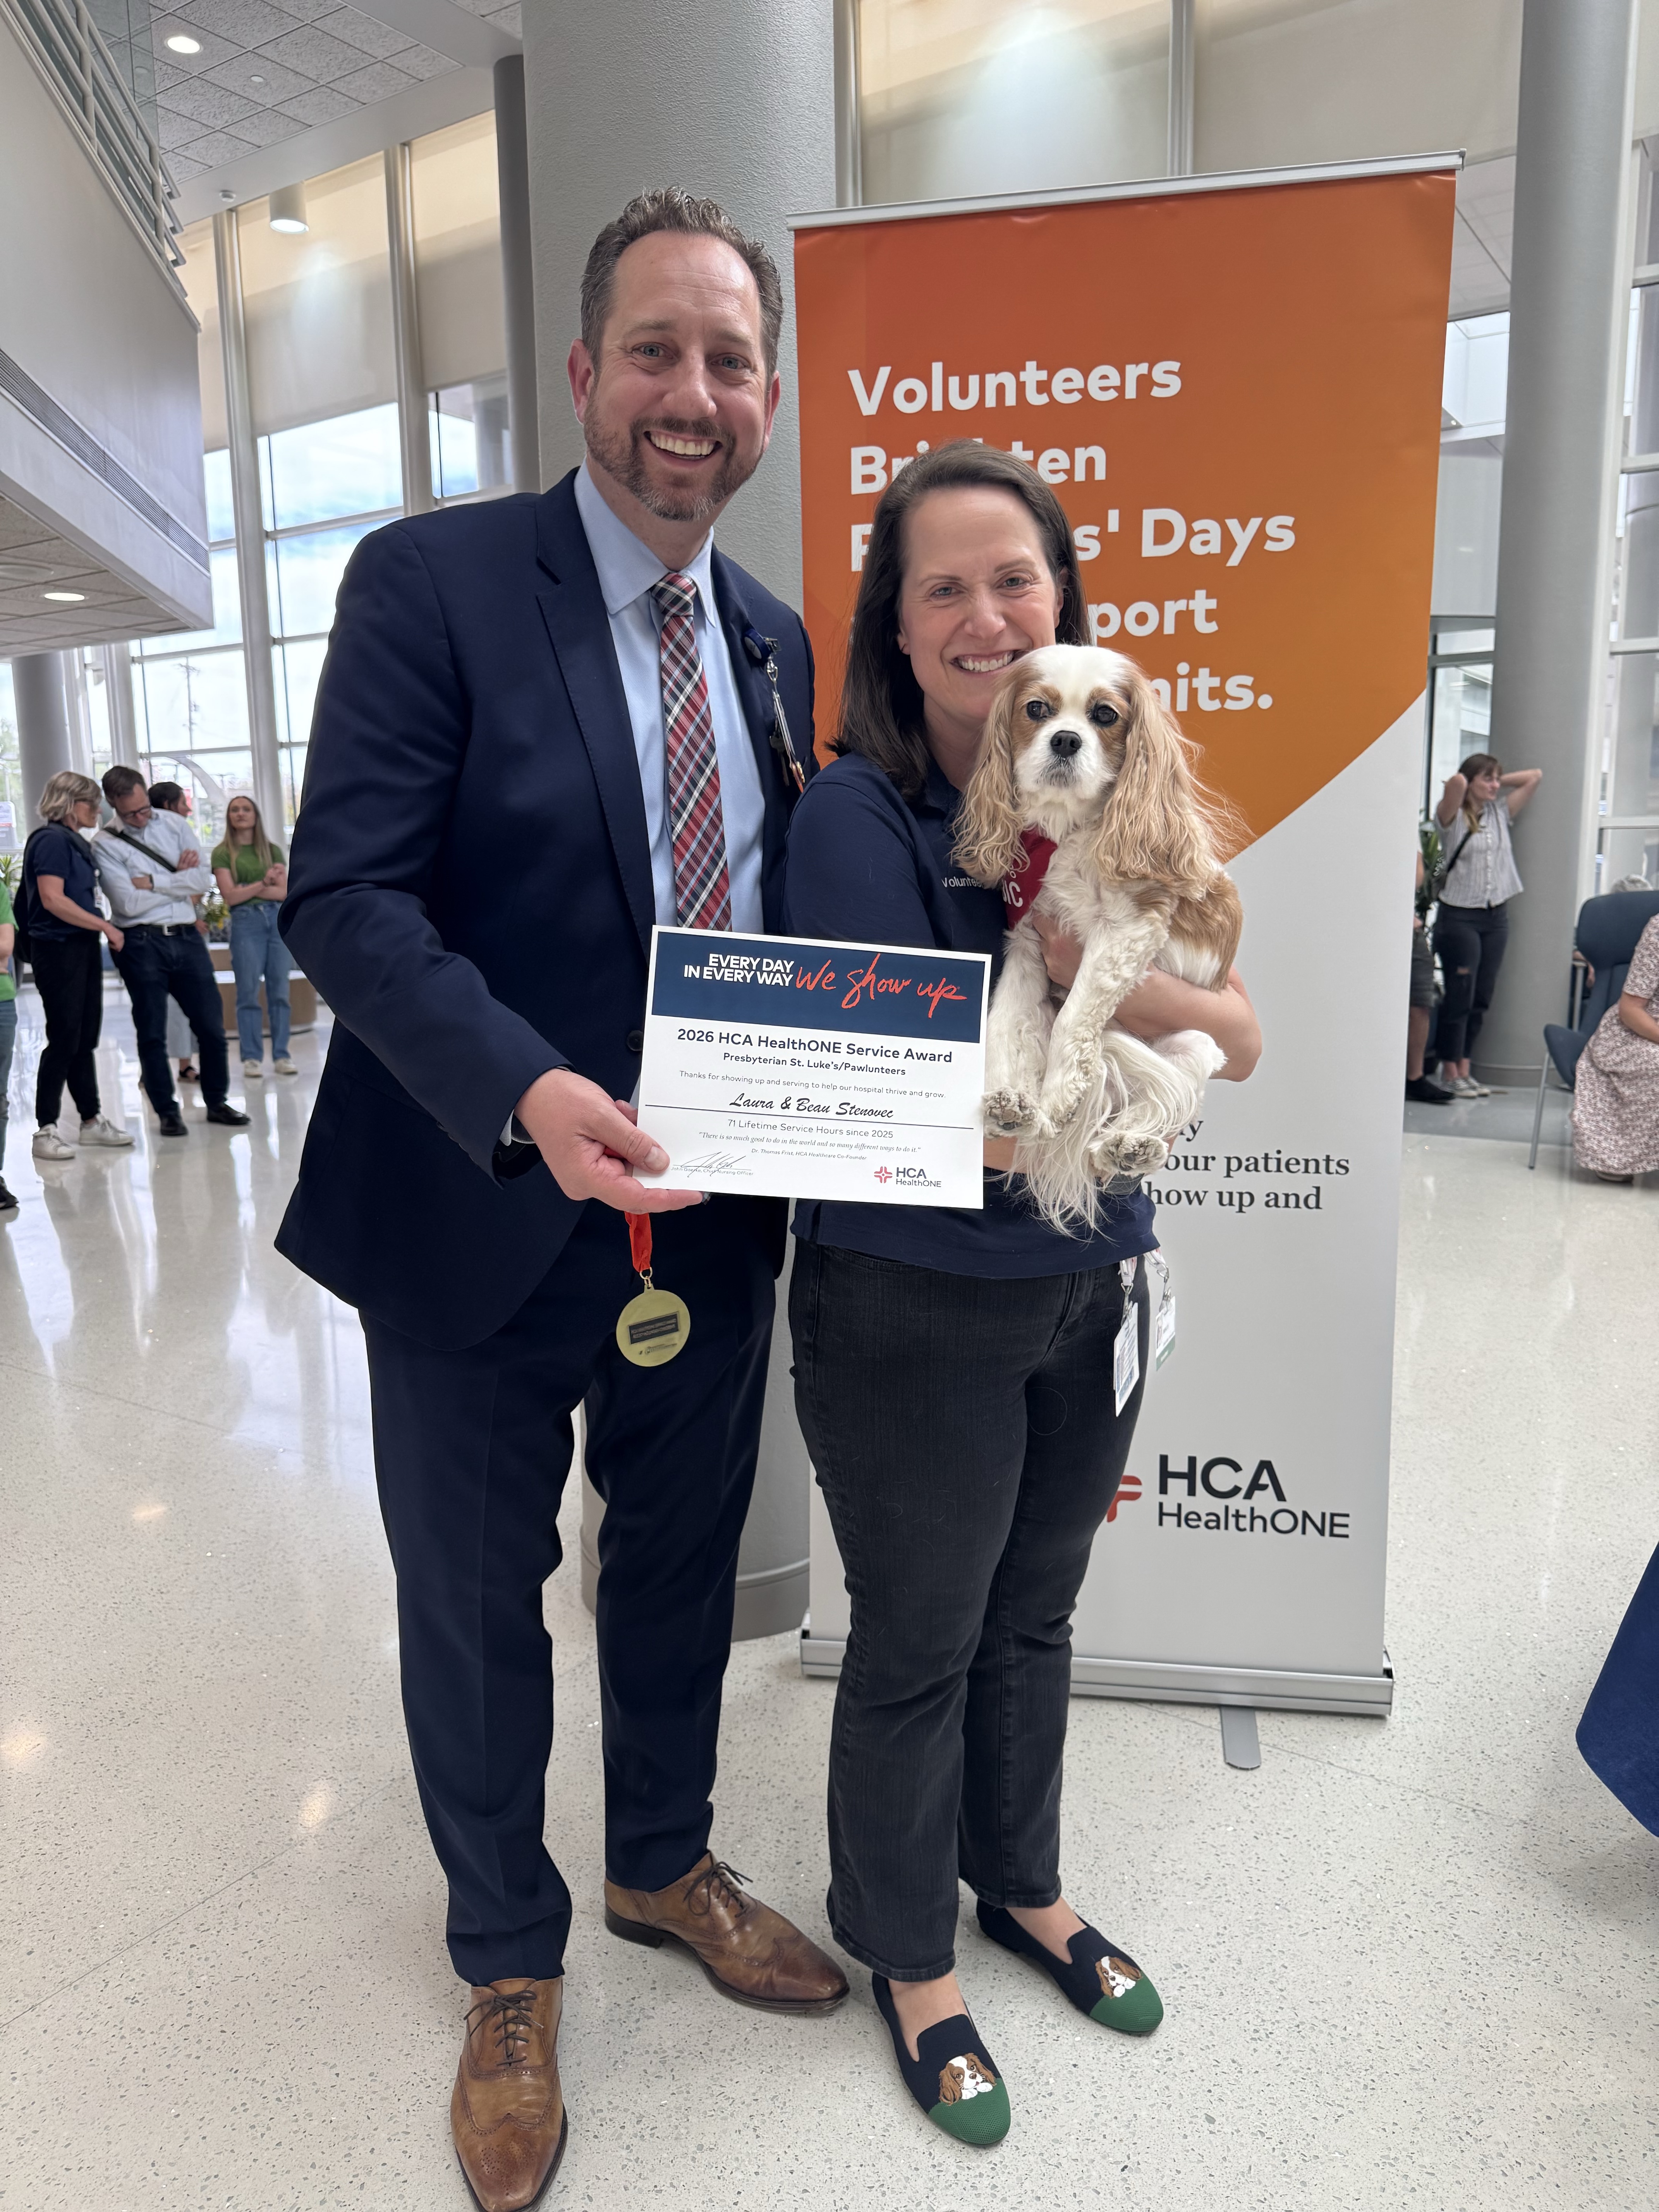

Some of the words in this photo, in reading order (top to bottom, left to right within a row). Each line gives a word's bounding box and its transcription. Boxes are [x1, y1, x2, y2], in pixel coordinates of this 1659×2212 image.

[847, 361, 1182, 416] Volunteers
[1142, 508, 1295, 567] Days
[1087, 589, 1218, 647] port
[684, 965, 700, 978] IN
[703, 967, 755, 982] EVERY
[757, 971, 793, 986] WAY
[709, 954, 760, 970] EVERY
[763, 958, 794, 973] DAY
[842, 953, 912, 1008] show
[678, 1029, 714, 1042] 2026
[719, 1032, 753, 1046] HCA
[758, 1036, 842, 1053] HealthONE
[846, 1043, 900, 1058] Service
[904, 1048, 952, 1062] Award
[723, 1053, 787, 1065] Presbyterian
[790, 1058, 804, 1066] St.
[722, 1074, 752, 1084] showing
[729, 1093, 775, 1109] Laura
[781, 1096, 792, 1109] &
[796, 1098, 830, 1113] Beau
[836, 1103, 894, 1118] Stenovec
[739, 1120, 777, 1130] Lifetime
[780, 1123, 813, 1132] Service
[817, 1126, 843, 1135] Hours
[896, 1167, 927, 1179] HCA
[1224, 1149, 1350, 1178] patients
[896, 1178, 941, 1187] HealthONE
[1144, 1182, 1208, 1206] how
[1216, 1190, 1254, 1213] up
[1264, 1186, 1322, 1209] and
[1159, 1454, 1286, 1501] HCA
[1158, 1502, 1350, 1538] HealthONE
